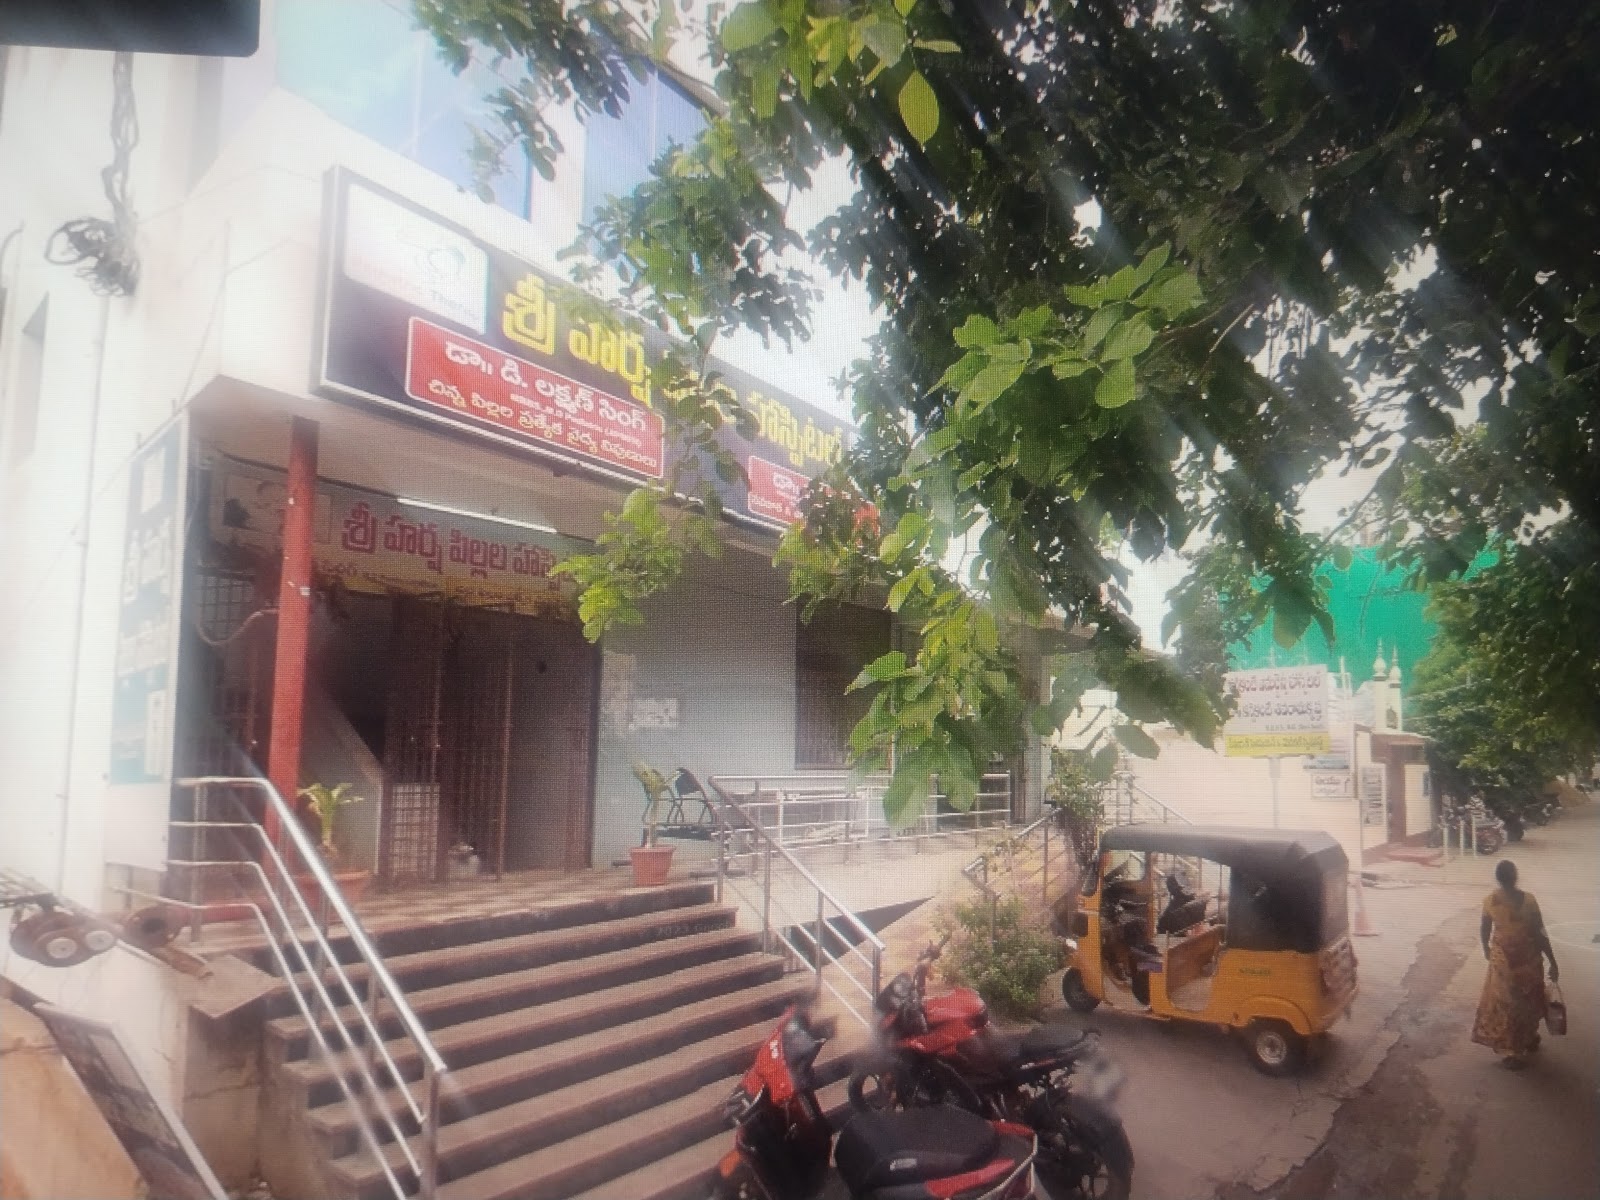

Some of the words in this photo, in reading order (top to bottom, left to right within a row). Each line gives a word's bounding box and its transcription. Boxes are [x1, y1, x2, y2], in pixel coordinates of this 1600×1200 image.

[502, 271, 555, 355] శ్రీ
[428, 378, 467, 409] చిన్న
[470, 391, 514, 420] పిల్లల
[341, 501, 377, 552] శ్రీ
[450, 529, 508, 579] పిల్లల
